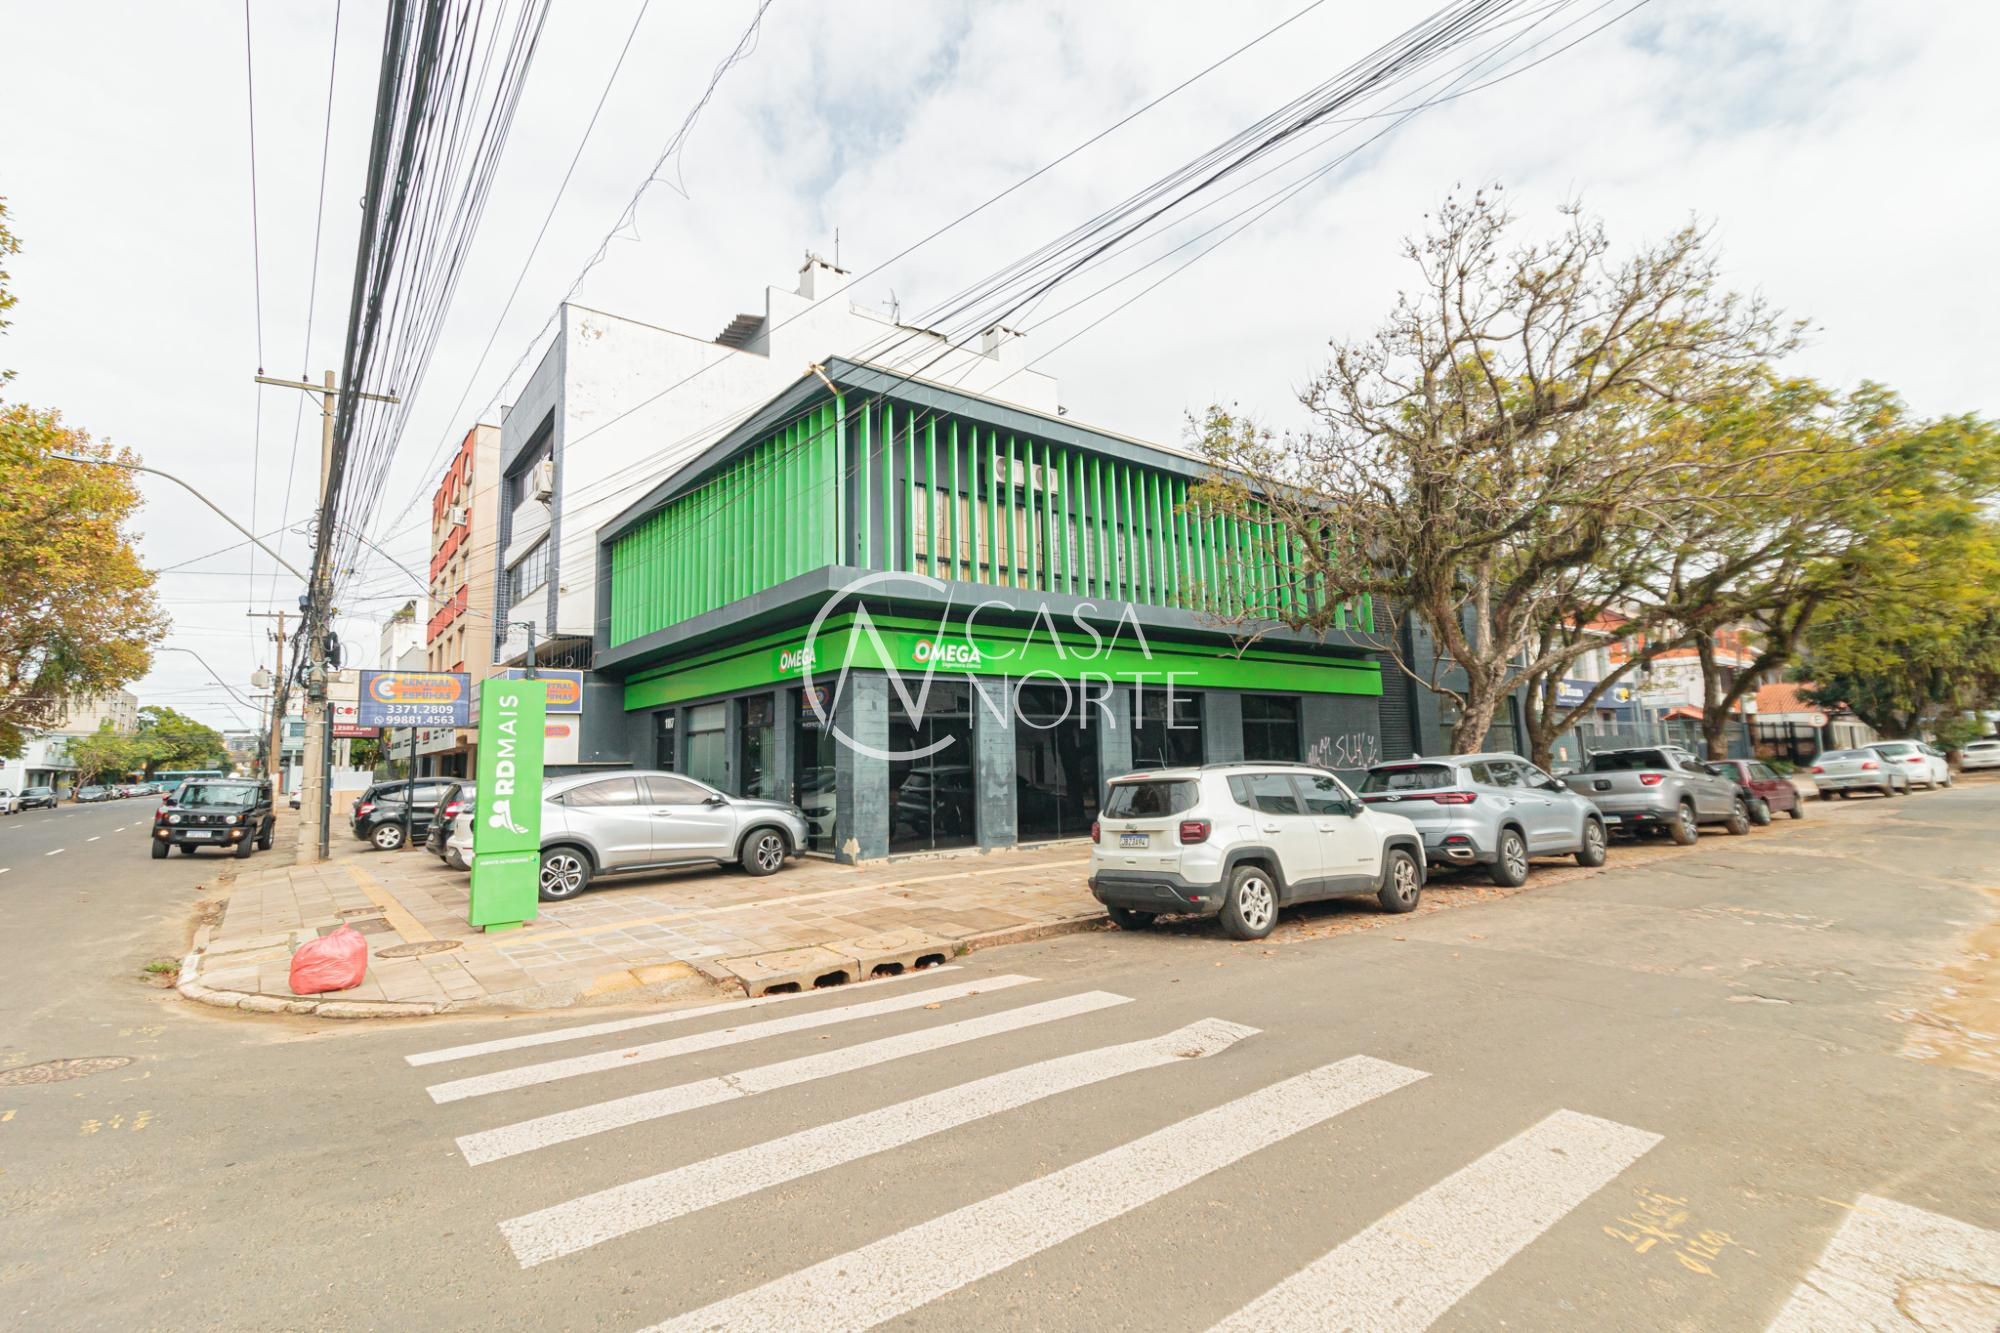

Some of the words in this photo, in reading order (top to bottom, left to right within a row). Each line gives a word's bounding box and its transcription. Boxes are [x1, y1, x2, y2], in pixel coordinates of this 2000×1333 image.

[780, 649, 816, 670] OMEGA
[914, 641, 981, 663] OMEGA
[387, 704, 454, 714] 3371.2809
[386, 715, 455, 725] 99881.4563
[495, 695, 519, 795] RDMAIS
